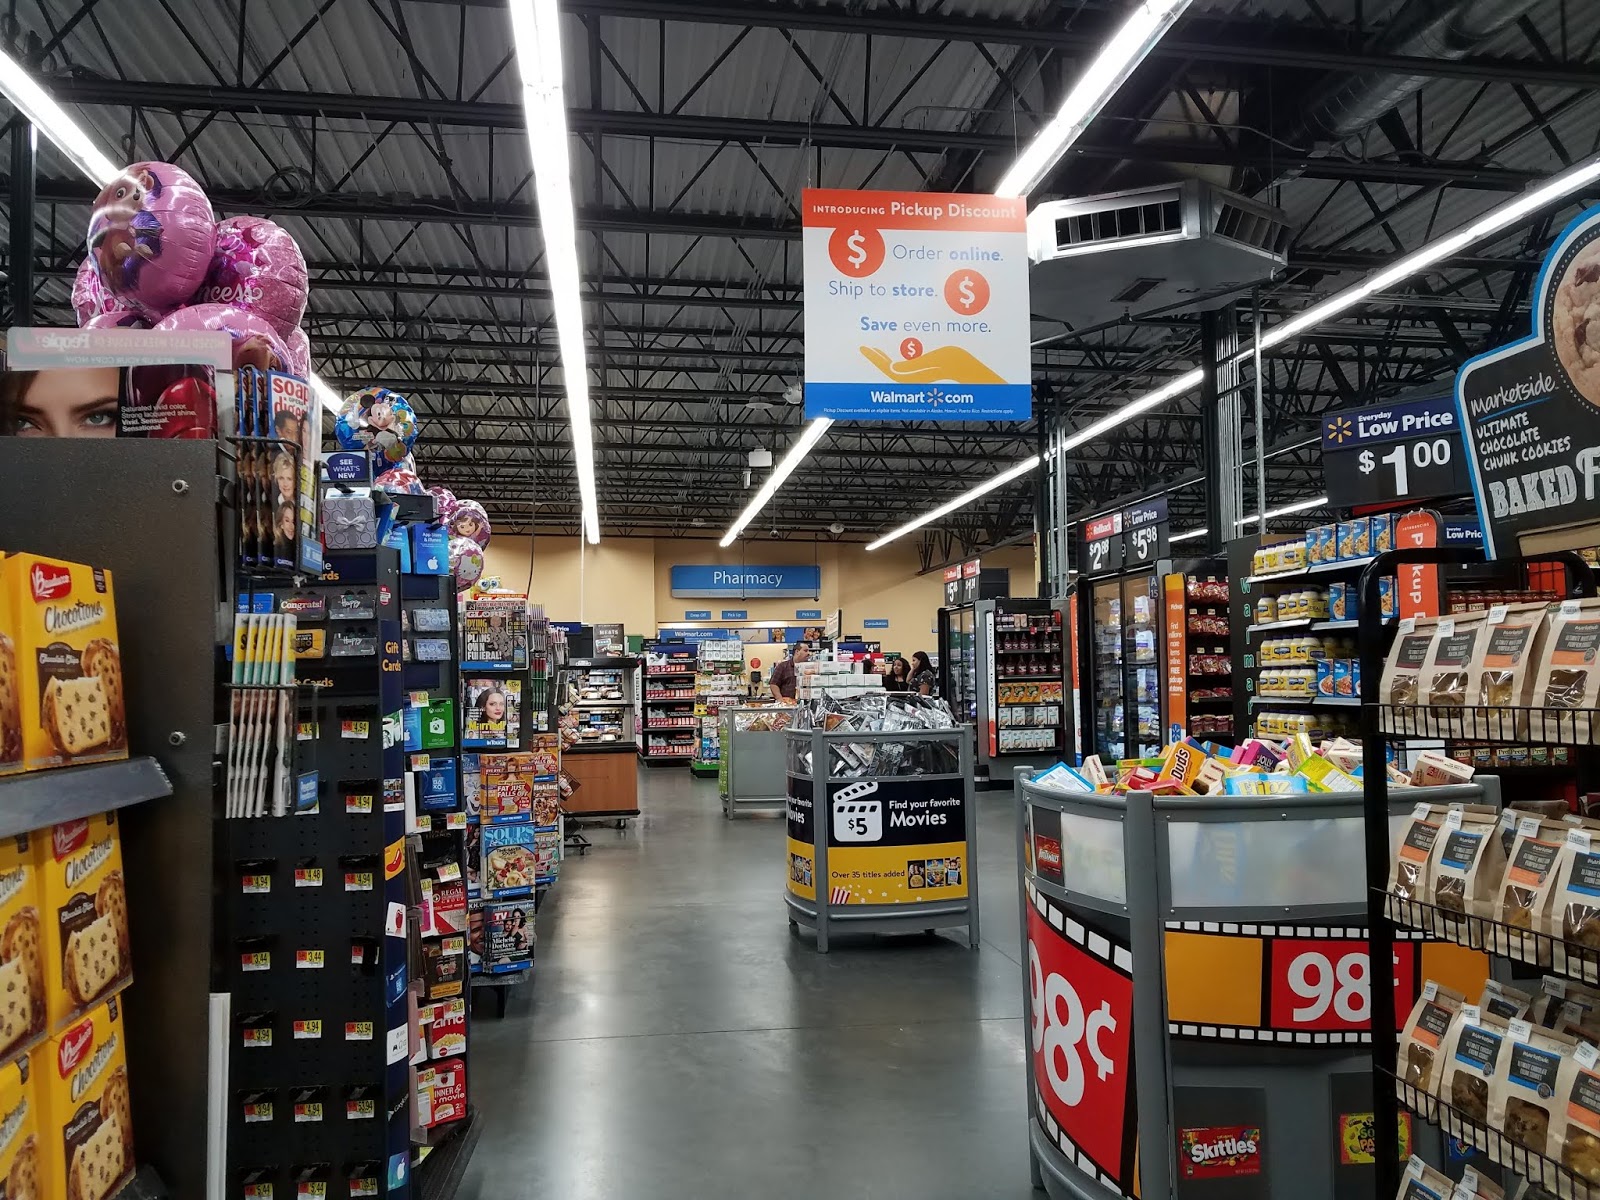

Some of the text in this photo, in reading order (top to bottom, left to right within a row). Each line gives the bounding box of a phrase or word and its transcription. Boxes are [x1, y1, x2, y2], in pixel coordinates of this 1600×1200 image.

[812, 202, 1017, 220] INTRODUCING Pickup Discount
[892, 244, 1004, 261] Order online.
[828, 280, 938, 300] Ship to store.
[860, 316, 992, 333] Save even more.
[272, 376, 309, 401] soap
[871, 391, 925, 403] Walmart
[121, 405, 152, 413] Saturated
[144, 411, 176, 419] lacquered
[1358, 411, 1392, 423] Everyday
[122, 424, 163, 432] Sensational.
[1358, 410, 1453, 438] Low Price
[1476, 412, 1530, 439] ULTIMATE
[1480, 426, 1541, 455] CHOCOLATE
[1483, 435, 1572, 472] CHUNK COOKIES
[1488, 465, 1578, 519] BAKED
[1132, 510, 1157, 525] Low Price
[1446, 530, 1483, 539] Low Pric
[713, 571, 783, 587] Pharmacy
[1150, 577, 1157, 587] A
[1150, 590, 1158, 598] 15
[281, 600, 323, 610] Congrats!
[341, 599, 360, 608] Happy
[467, 619, 487, 627] DYING
[343, 636, 362, 645] Happy
[385, 641, 399, 654] Gift
[382, 659, 401, 672] Cards
[1171, 748, 1190, 782] Duds
[1257, 754, 1274, 768] JOLLY
[888, 798, 961, 811] Find your favorite
[889, 810, 947, 828] Movies
[848, 817, 868, 836] $5
[485, 826, 535, 841] SOUPS
[831, 871, 850, 879] Over
[851, 871, 860, 879] 35
[883, 870, 905, 878] added
[441, 887, 463, 896] REGAL
[494, 911, 508, 920] TV
[1287, 951, 1399, 1023] 98
[432, 1015, 465, 1029] amc
[434, 1086, 454, 1098] INNER
[439, 1092, 465, 1104] movie
[1361, 1127, 1375, 1139] SO
[1191, 1138, 1257, 1163] Skittles
